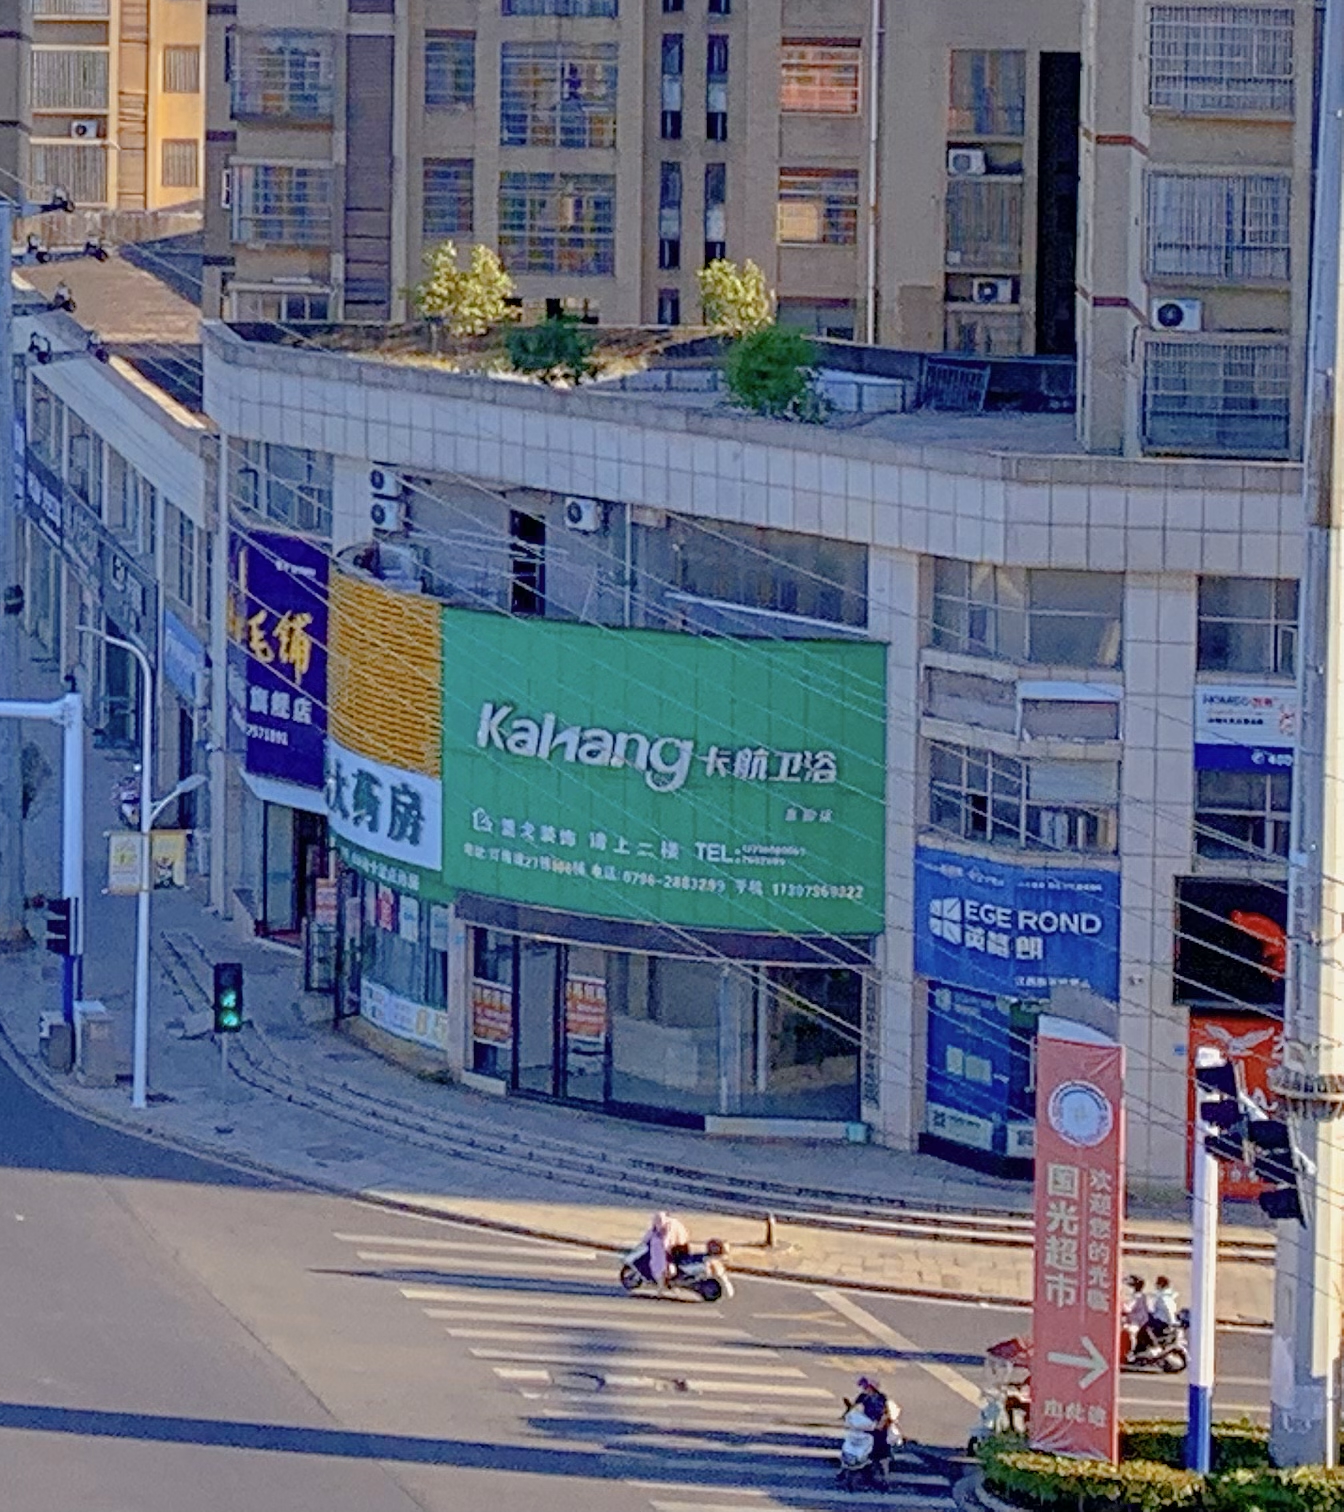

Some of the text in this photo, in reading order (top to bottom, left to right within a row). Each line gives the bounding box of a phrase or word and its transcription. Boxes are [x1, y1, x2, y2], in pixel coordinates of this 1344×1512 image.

[698, 745, 838, 783] 卡航卫浴
[964, 899, 1103, 934] EGE ROND
[1044, 1162, 1079, 1308] 国光超市
